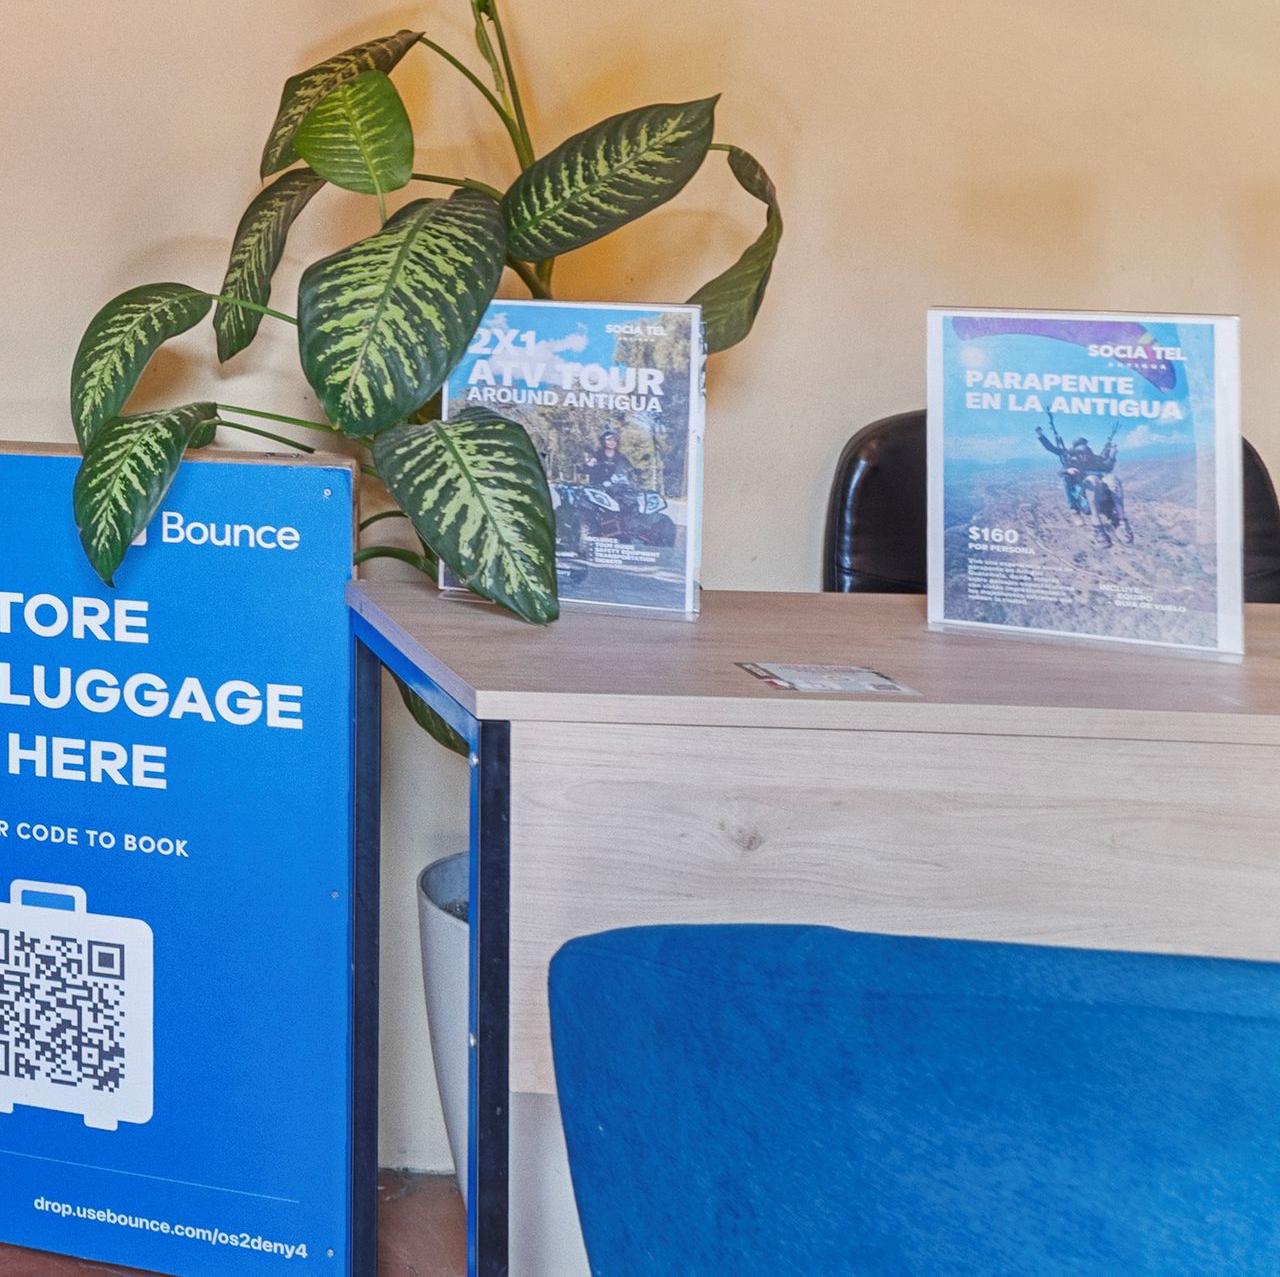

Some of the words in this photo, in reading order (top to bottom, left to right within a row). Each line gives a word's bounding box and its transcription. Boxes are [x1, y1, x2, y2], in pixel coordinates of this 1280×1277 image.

[468, 329, 537, 355] 2X1
[468, 359, 547, 388] ATV
[557, 362, 664, 396] TOUR
[965, 371, 1134, 395] PARAPENTE
[467, 386, 558, 405] AROUND
[563, 392, 662, 412] ANTIGUA
[965, 392, 1001, 410] EN
[1008, 394, 1043, 412] LA
[1051, 397, 1183, 420] ANTIGUA
[162, 511, 300, 551] Bounce
[968, 526, 1019, 543] $160
[968, 543, 988, 551] POR
[990, 544, 1035, 555] PERSONA
[1154, 604, 1186, 613] VUELO
[0, 662, 304, 730] LUGGAGE
[8, 732, 168, 790] HERE
[16, 822, 79, 846] CODE
[85, 827, 116, 850] TO
[124, 831, 189, 858] BOOK
[34, 1196, 308, 1259] drop.usebounce.com/os2deny4
